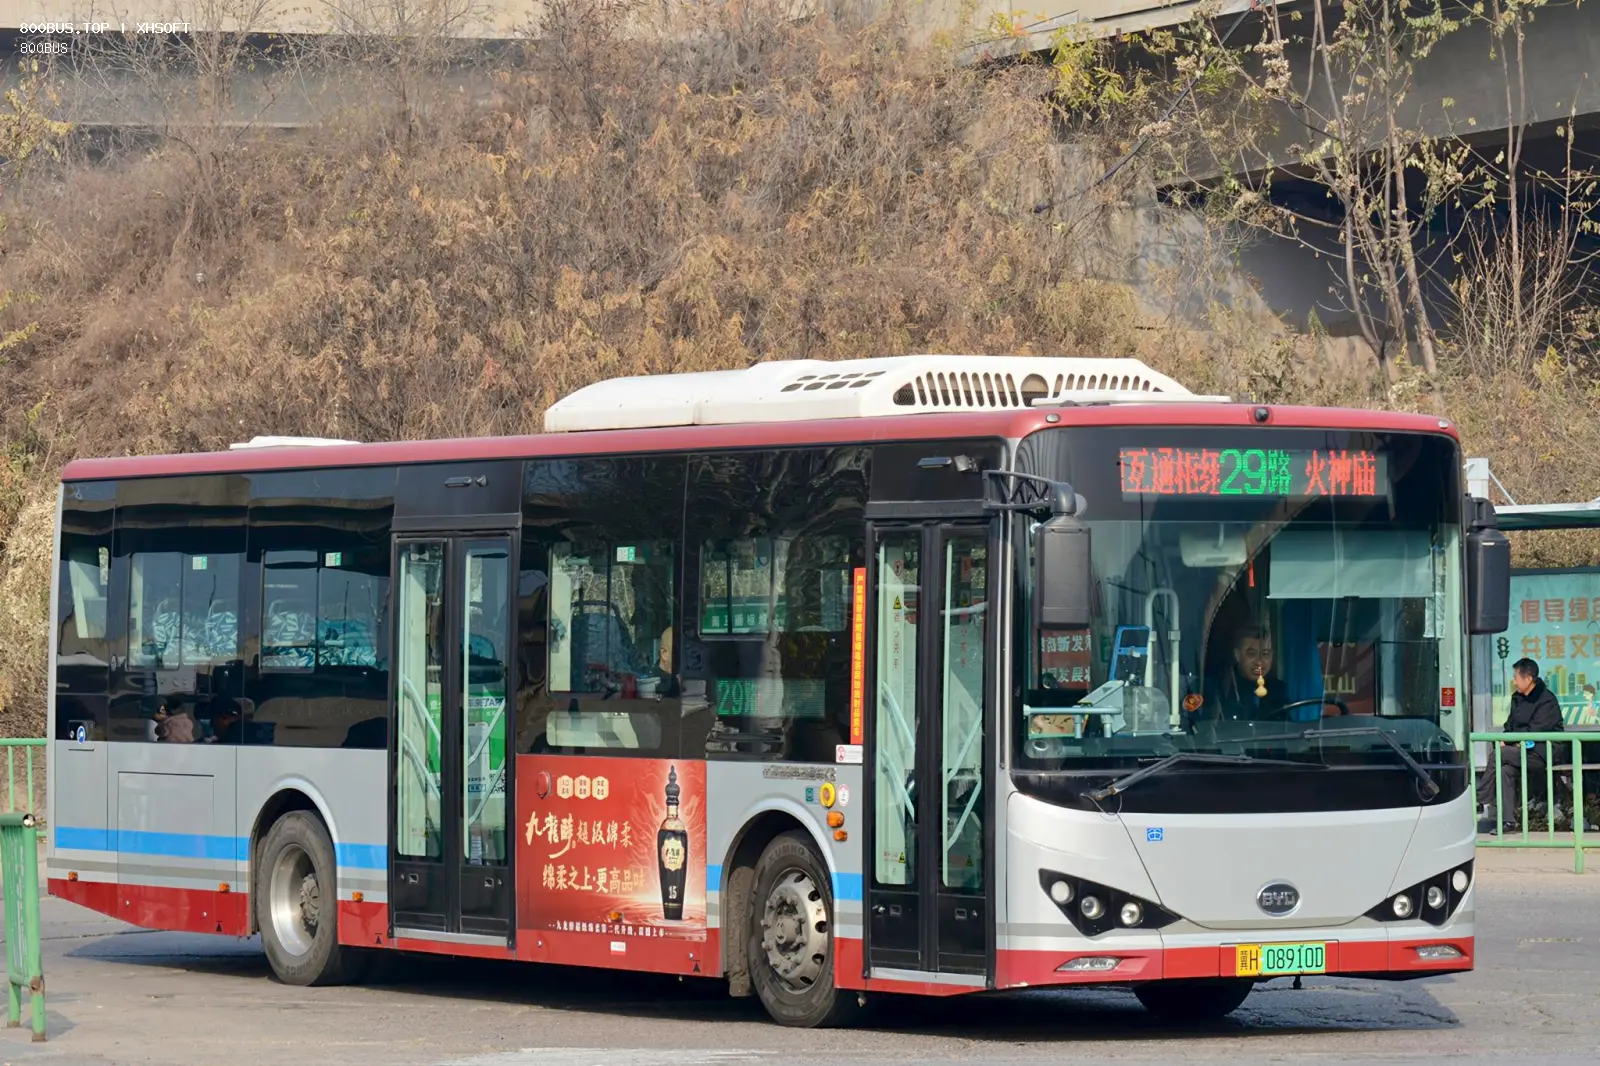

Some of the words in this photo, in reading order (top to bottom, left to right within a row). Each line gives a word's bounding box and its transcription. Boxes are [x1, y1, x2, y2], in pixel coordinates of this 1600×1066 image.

[1119, 448, 1220, 495] 互通枢纽
[1219, 448, 1292, 495] 29路
[1304, 449, 1377, 496] 火神庙
[577, 819, 633, 850] 超级绵柔
[1262, 891, 1296, 906] BYD
